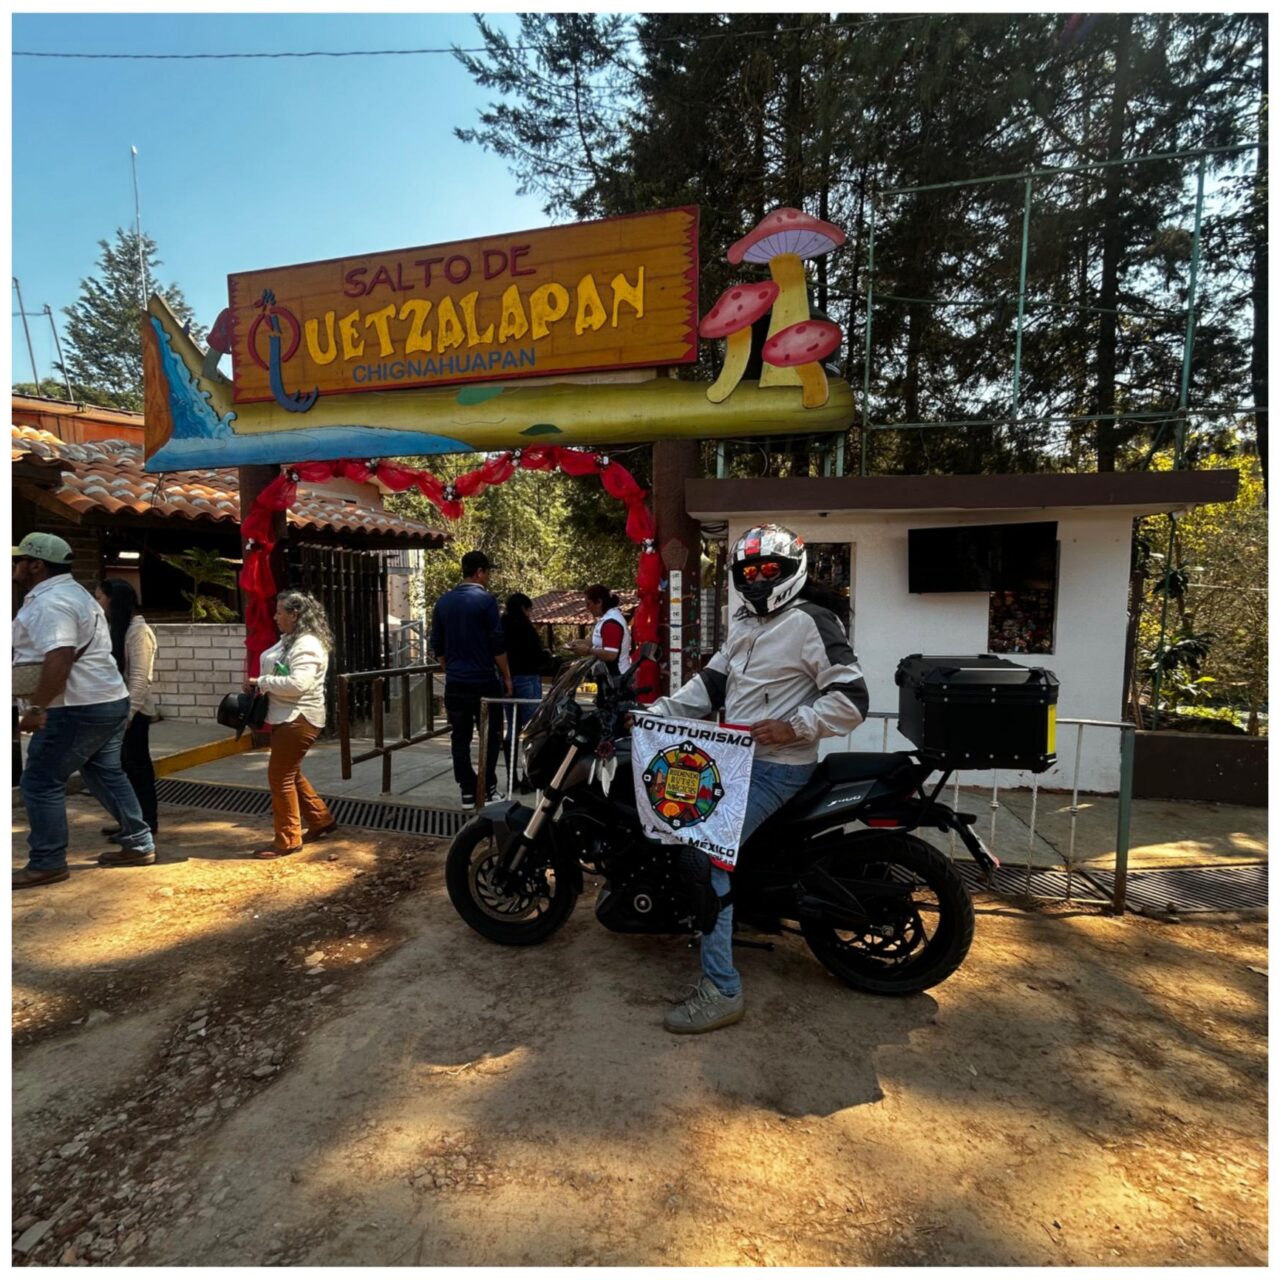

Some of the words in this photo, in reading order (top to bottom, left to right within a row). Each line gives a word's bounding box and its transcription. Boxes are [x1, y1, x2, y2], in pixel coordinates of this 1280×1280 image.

[344, 255, 472, 298] SALTO
[483, 243, 537, 279] DE
[351, 347, 537, 385] CHIGNAHUAPAN
[632, 717, 754, 748] MOTOTURISMO
[683, 744, 693, 752] N
[714, 788, 723, 796] E
[687, 837, 736, 858] MÉXICO
